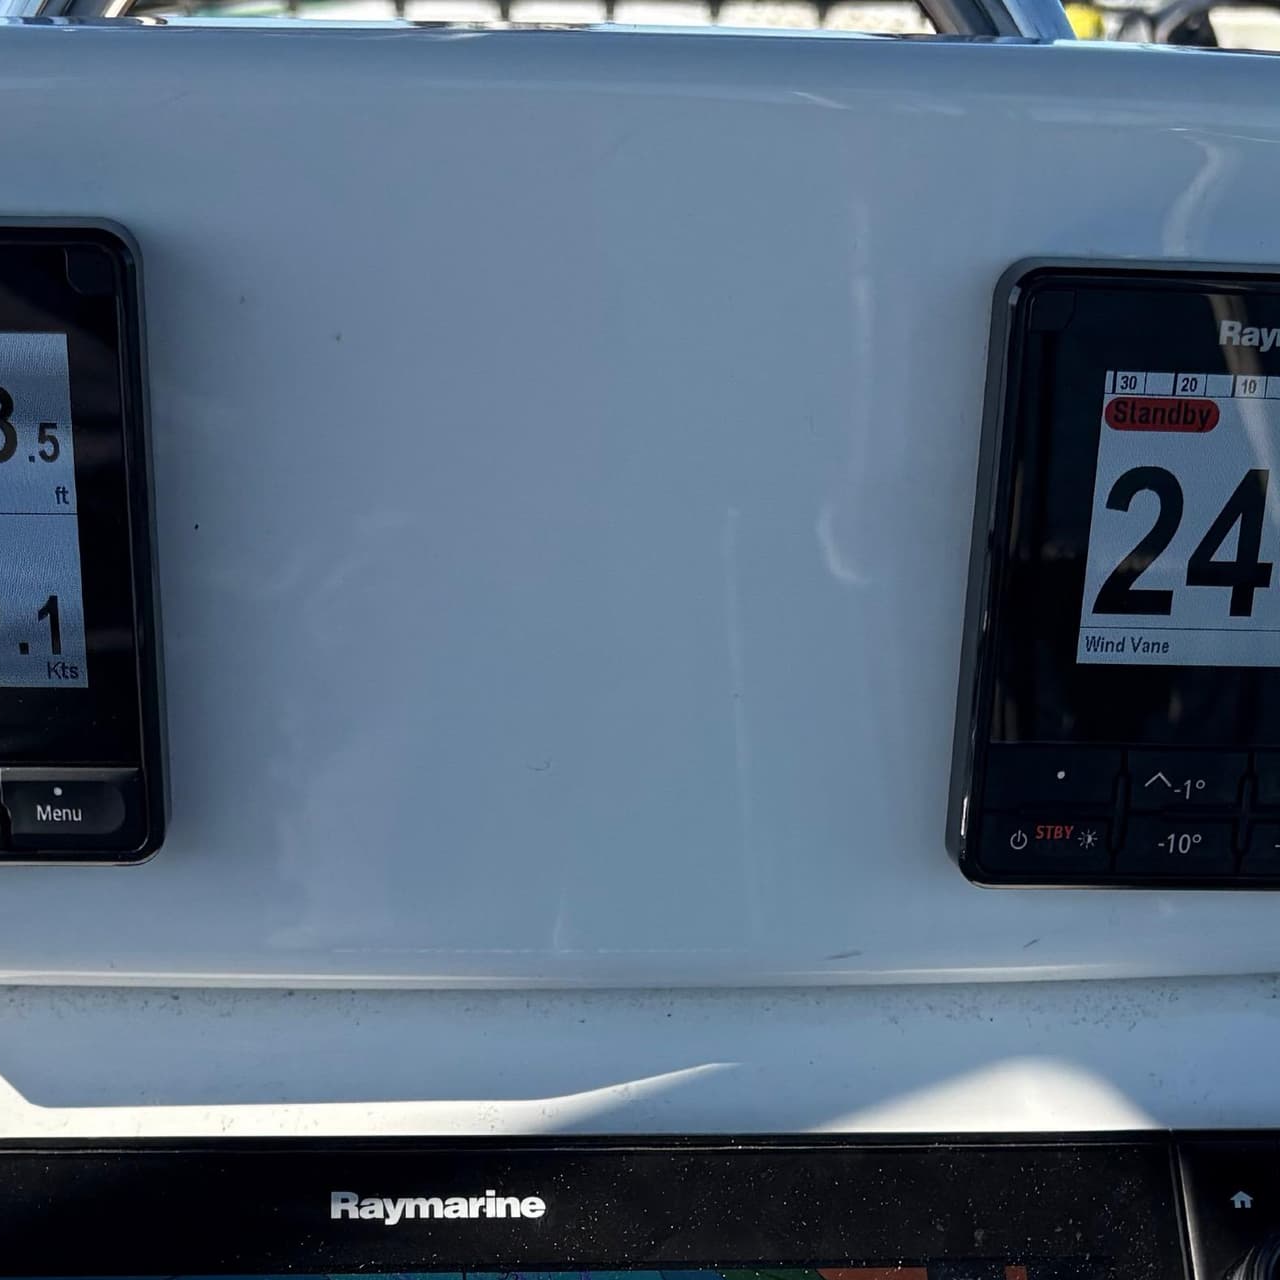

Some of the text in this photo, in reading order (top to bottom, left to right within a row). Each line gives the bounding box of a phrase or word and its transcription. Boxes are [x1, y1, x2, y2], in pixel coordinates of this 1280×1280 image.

[1120, 376, 1137, 391] 30
[1181, 378, 1198, 392] 20
[1241, 379, 1258, 394] 10
[1112, 400, 1212, 432] Standby
[55, 486, 70, 505] ft
[1085, 636, 1170, 654] Wind Vane
[47, 662, 79, 680] Kts
[1174, 779, 1205, 798] -1°
[36, 804, 83, 823] Menu
[1035, 824, 1074, 840] STBY
[1158, 833, 1202, 855] -10°
[330, 1190, 546, 1226] Raymarine
